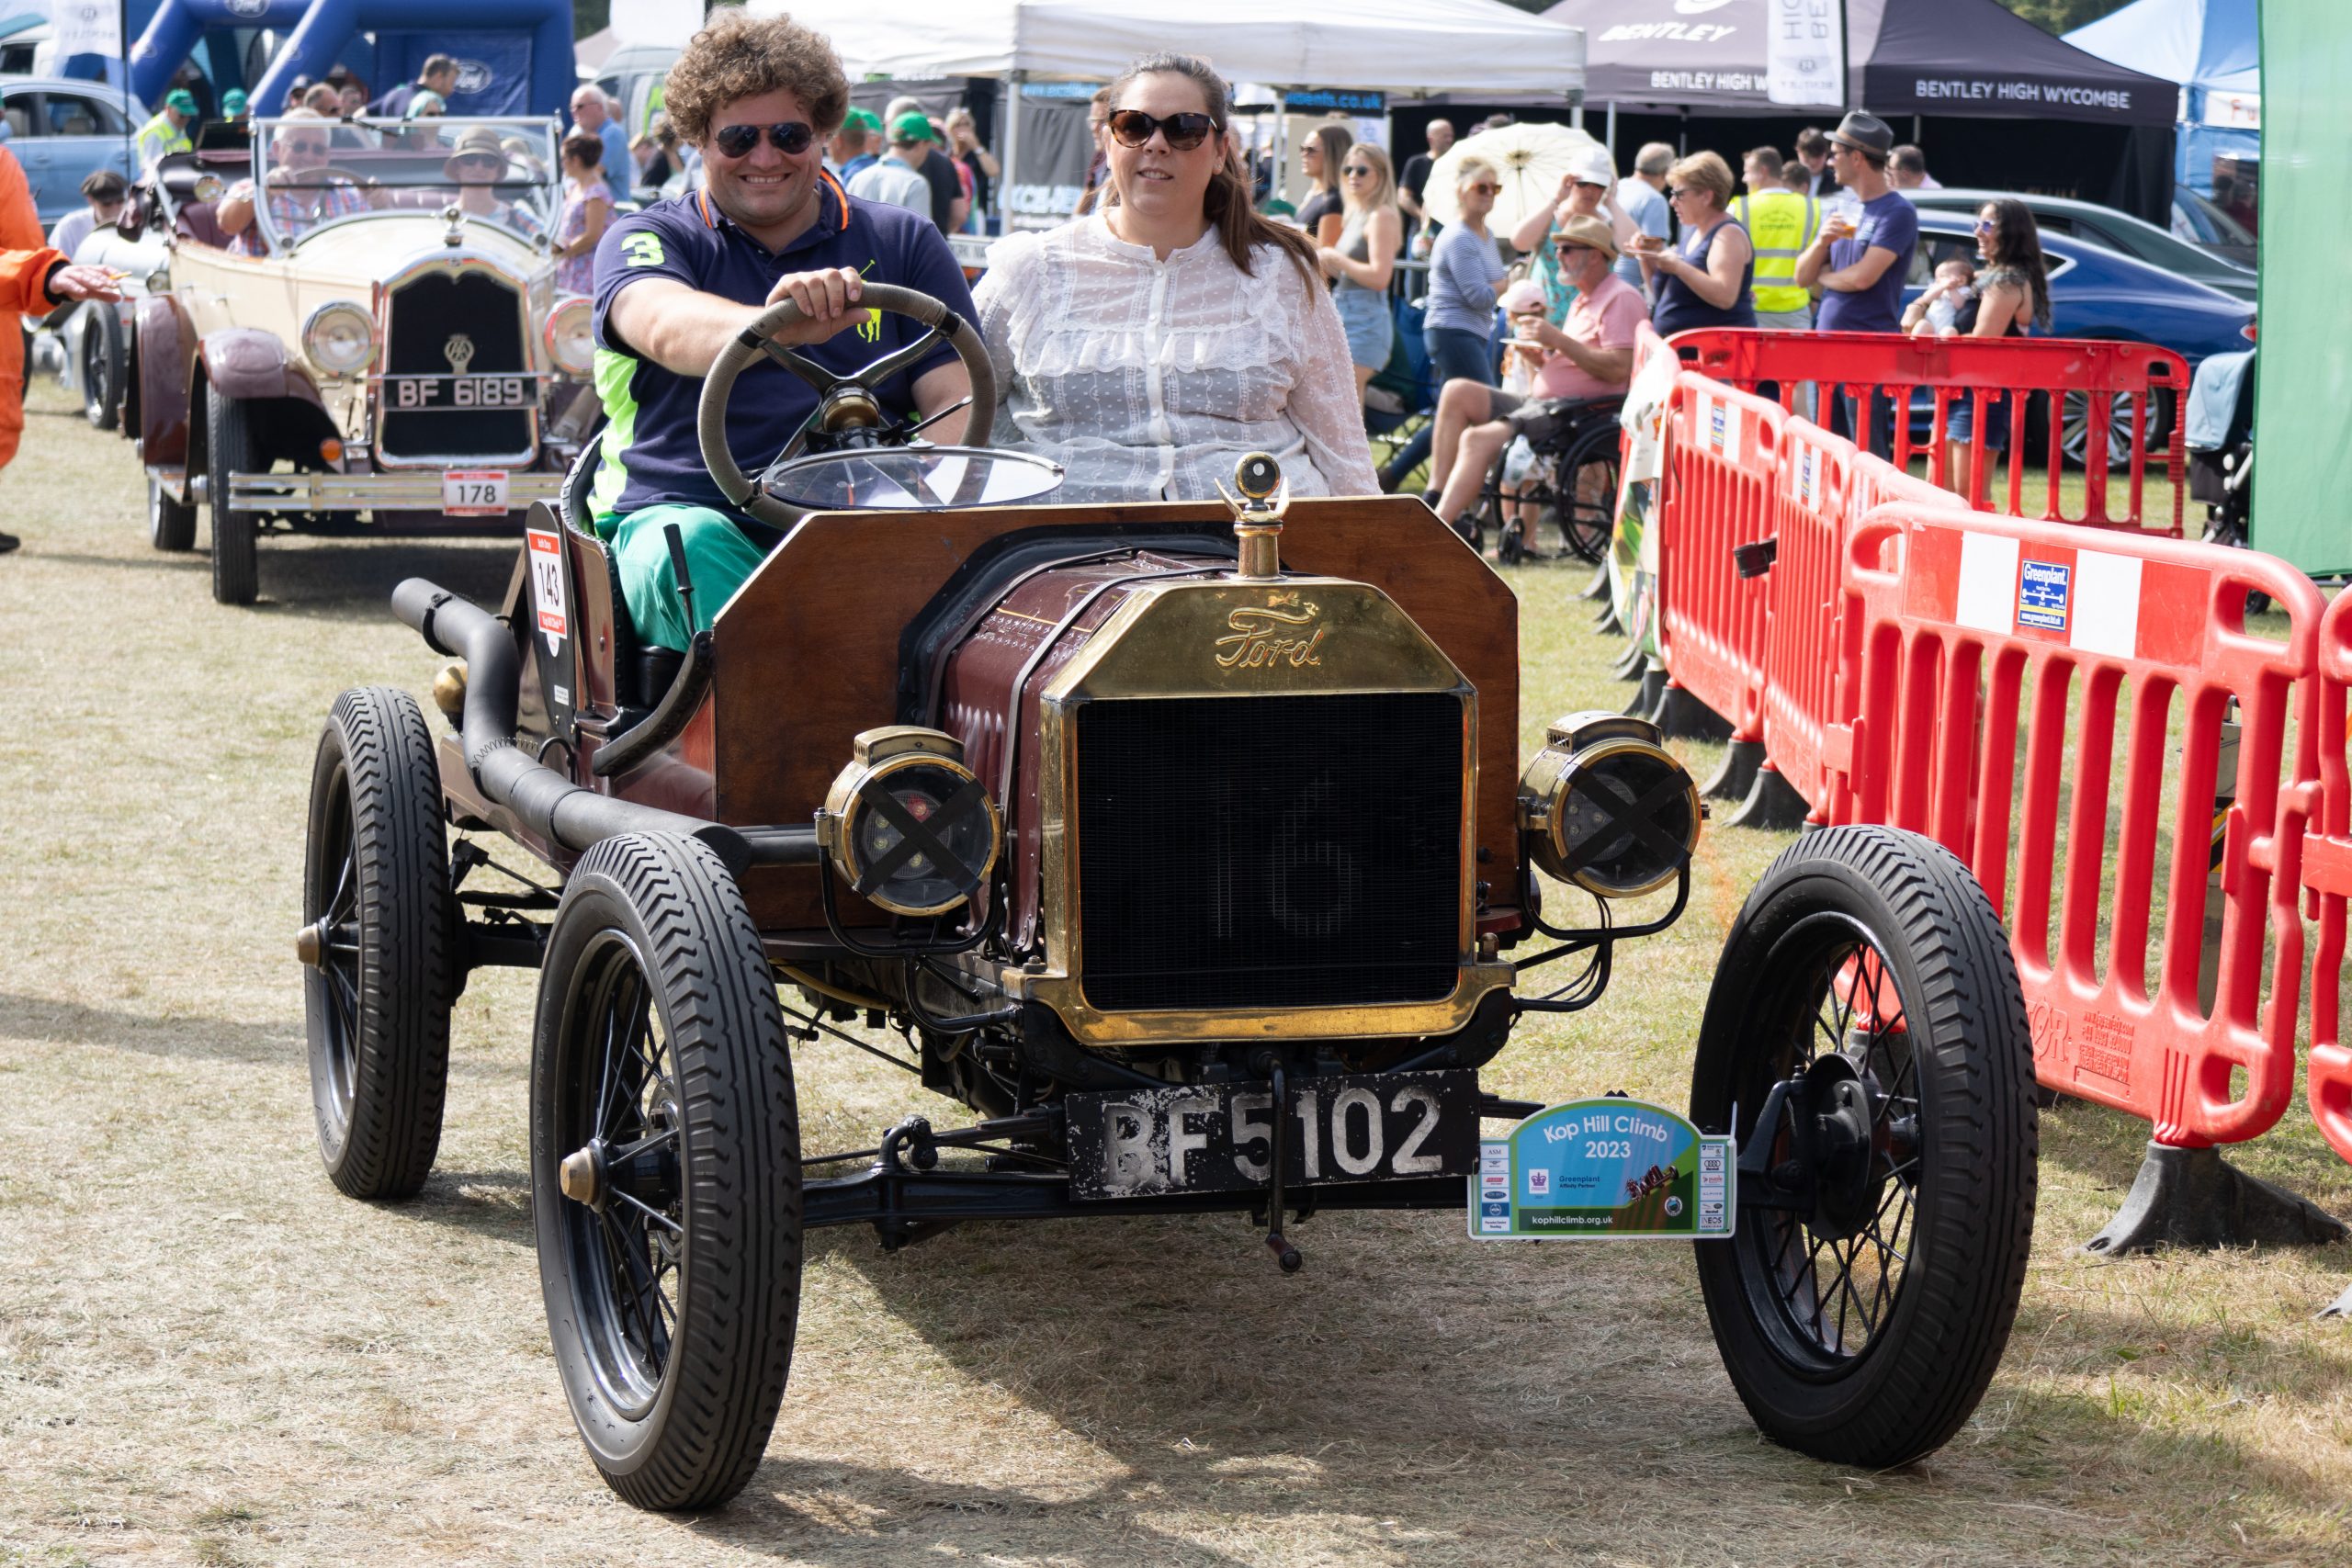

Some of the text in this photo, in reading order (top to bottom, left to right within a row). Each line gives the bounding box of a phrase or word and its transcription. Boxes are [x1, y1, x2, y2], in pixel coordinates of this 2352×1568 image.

[1598, 21, 1737, 42] BENTLEY
[1651, 71, 1714, 90] BENTLEY
[1716, 73, 1752, 91] HIGH
[1916, 80, 2132, 109] BENTLEY HIGH WYCOMBE
[621, 231, 665, 267] 3
[398, 378, 524, 407] BF 6189
[458, 484, 497, 504] 178
[538, 561, 560, 607] 143
[1216, 602, 1324, 668] Ford
[1544, 1115, 1668, 1144] Kop Hill Climb
[1585, 1141, 1631, 1158] 2023
[1532, 1215, 1613, 1225] kophillclimb.org.uk
